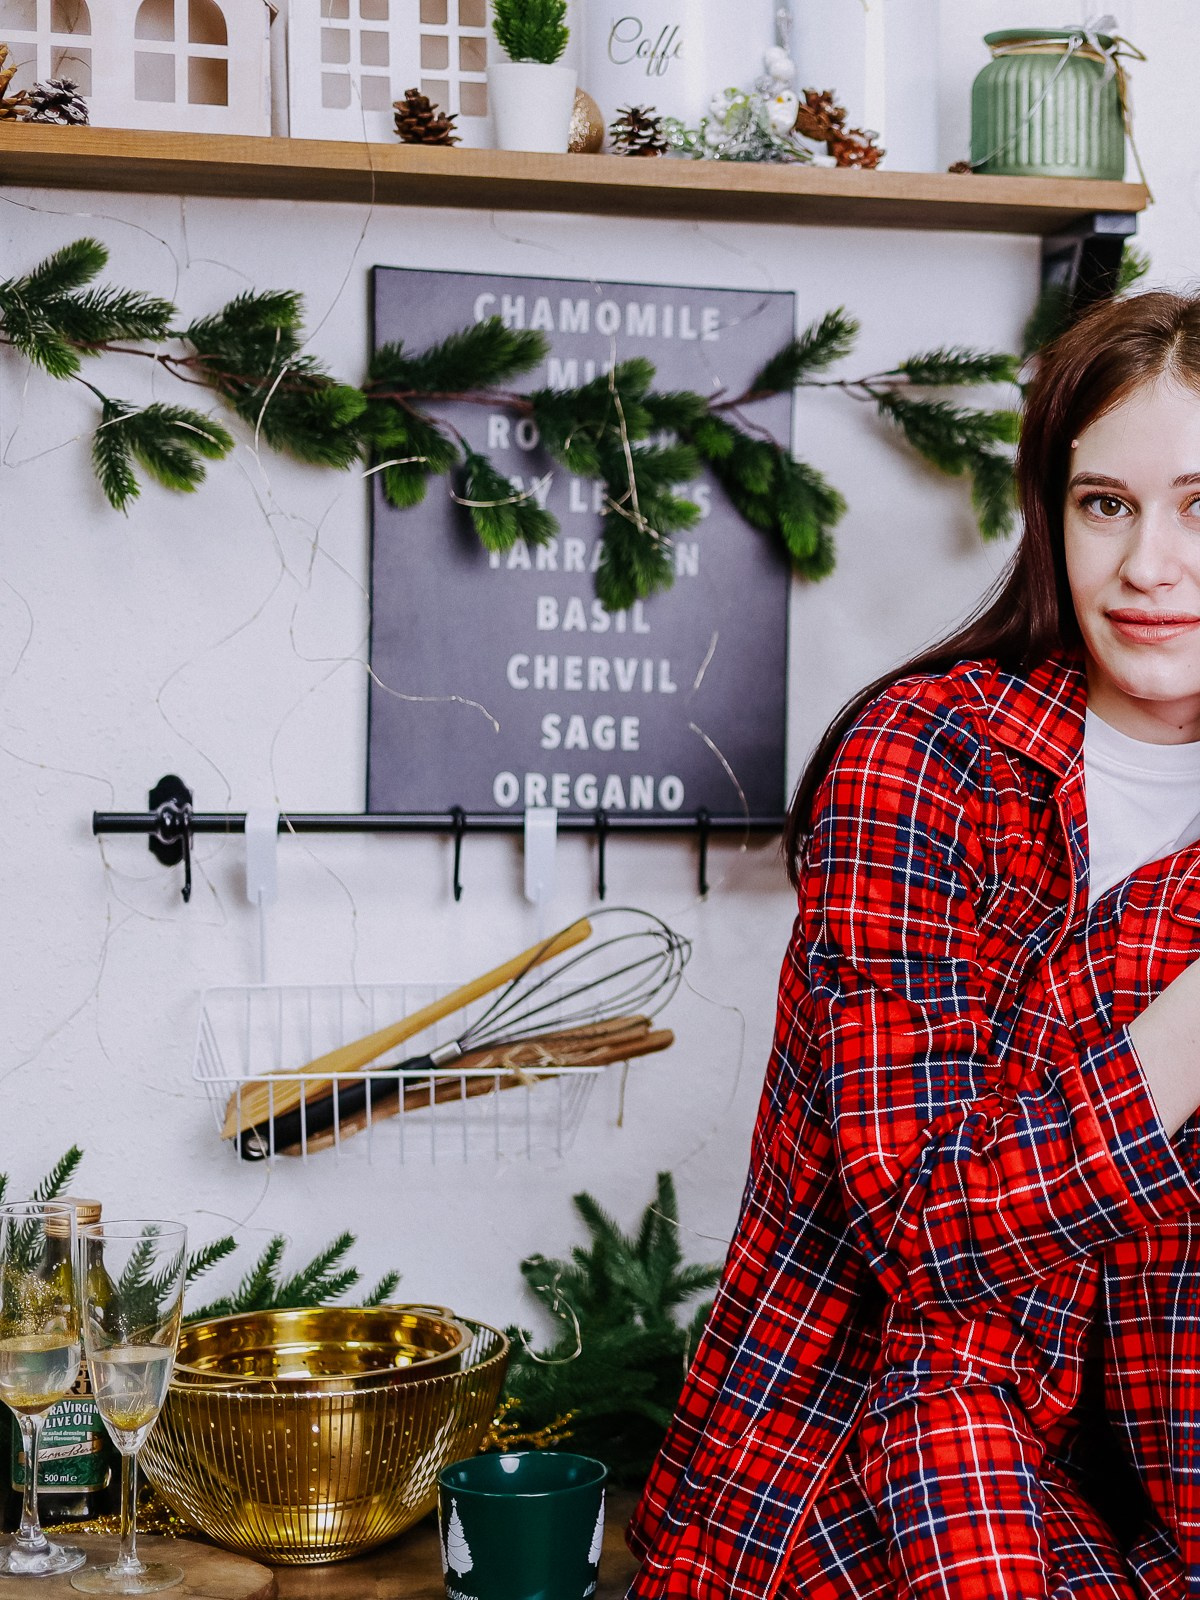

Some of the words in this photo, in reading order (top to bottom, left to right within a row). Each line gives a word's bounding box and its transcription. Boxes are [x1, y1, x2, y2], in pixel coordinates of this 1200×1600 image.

[473, 292, 721, 342] CHAMOMILE
[547, 357, 613, 389] MI
[508, 474, 553, 510] AY
[536, 595, 651, 634] BASIL
[506, 653, 678, 694] CHERVIL
[540, 712, 641, 751] SAGE
[493, 770, 685, 812] OREGANO
[45, 1416, 71, 1429] LIVE
[73, 1413, 93, 1426] OIL
[63, 1401, 99, 1415] VIRGIN
[44, 1474, 58, 1482] 500
[60, 1473, 69, 1482] ml
